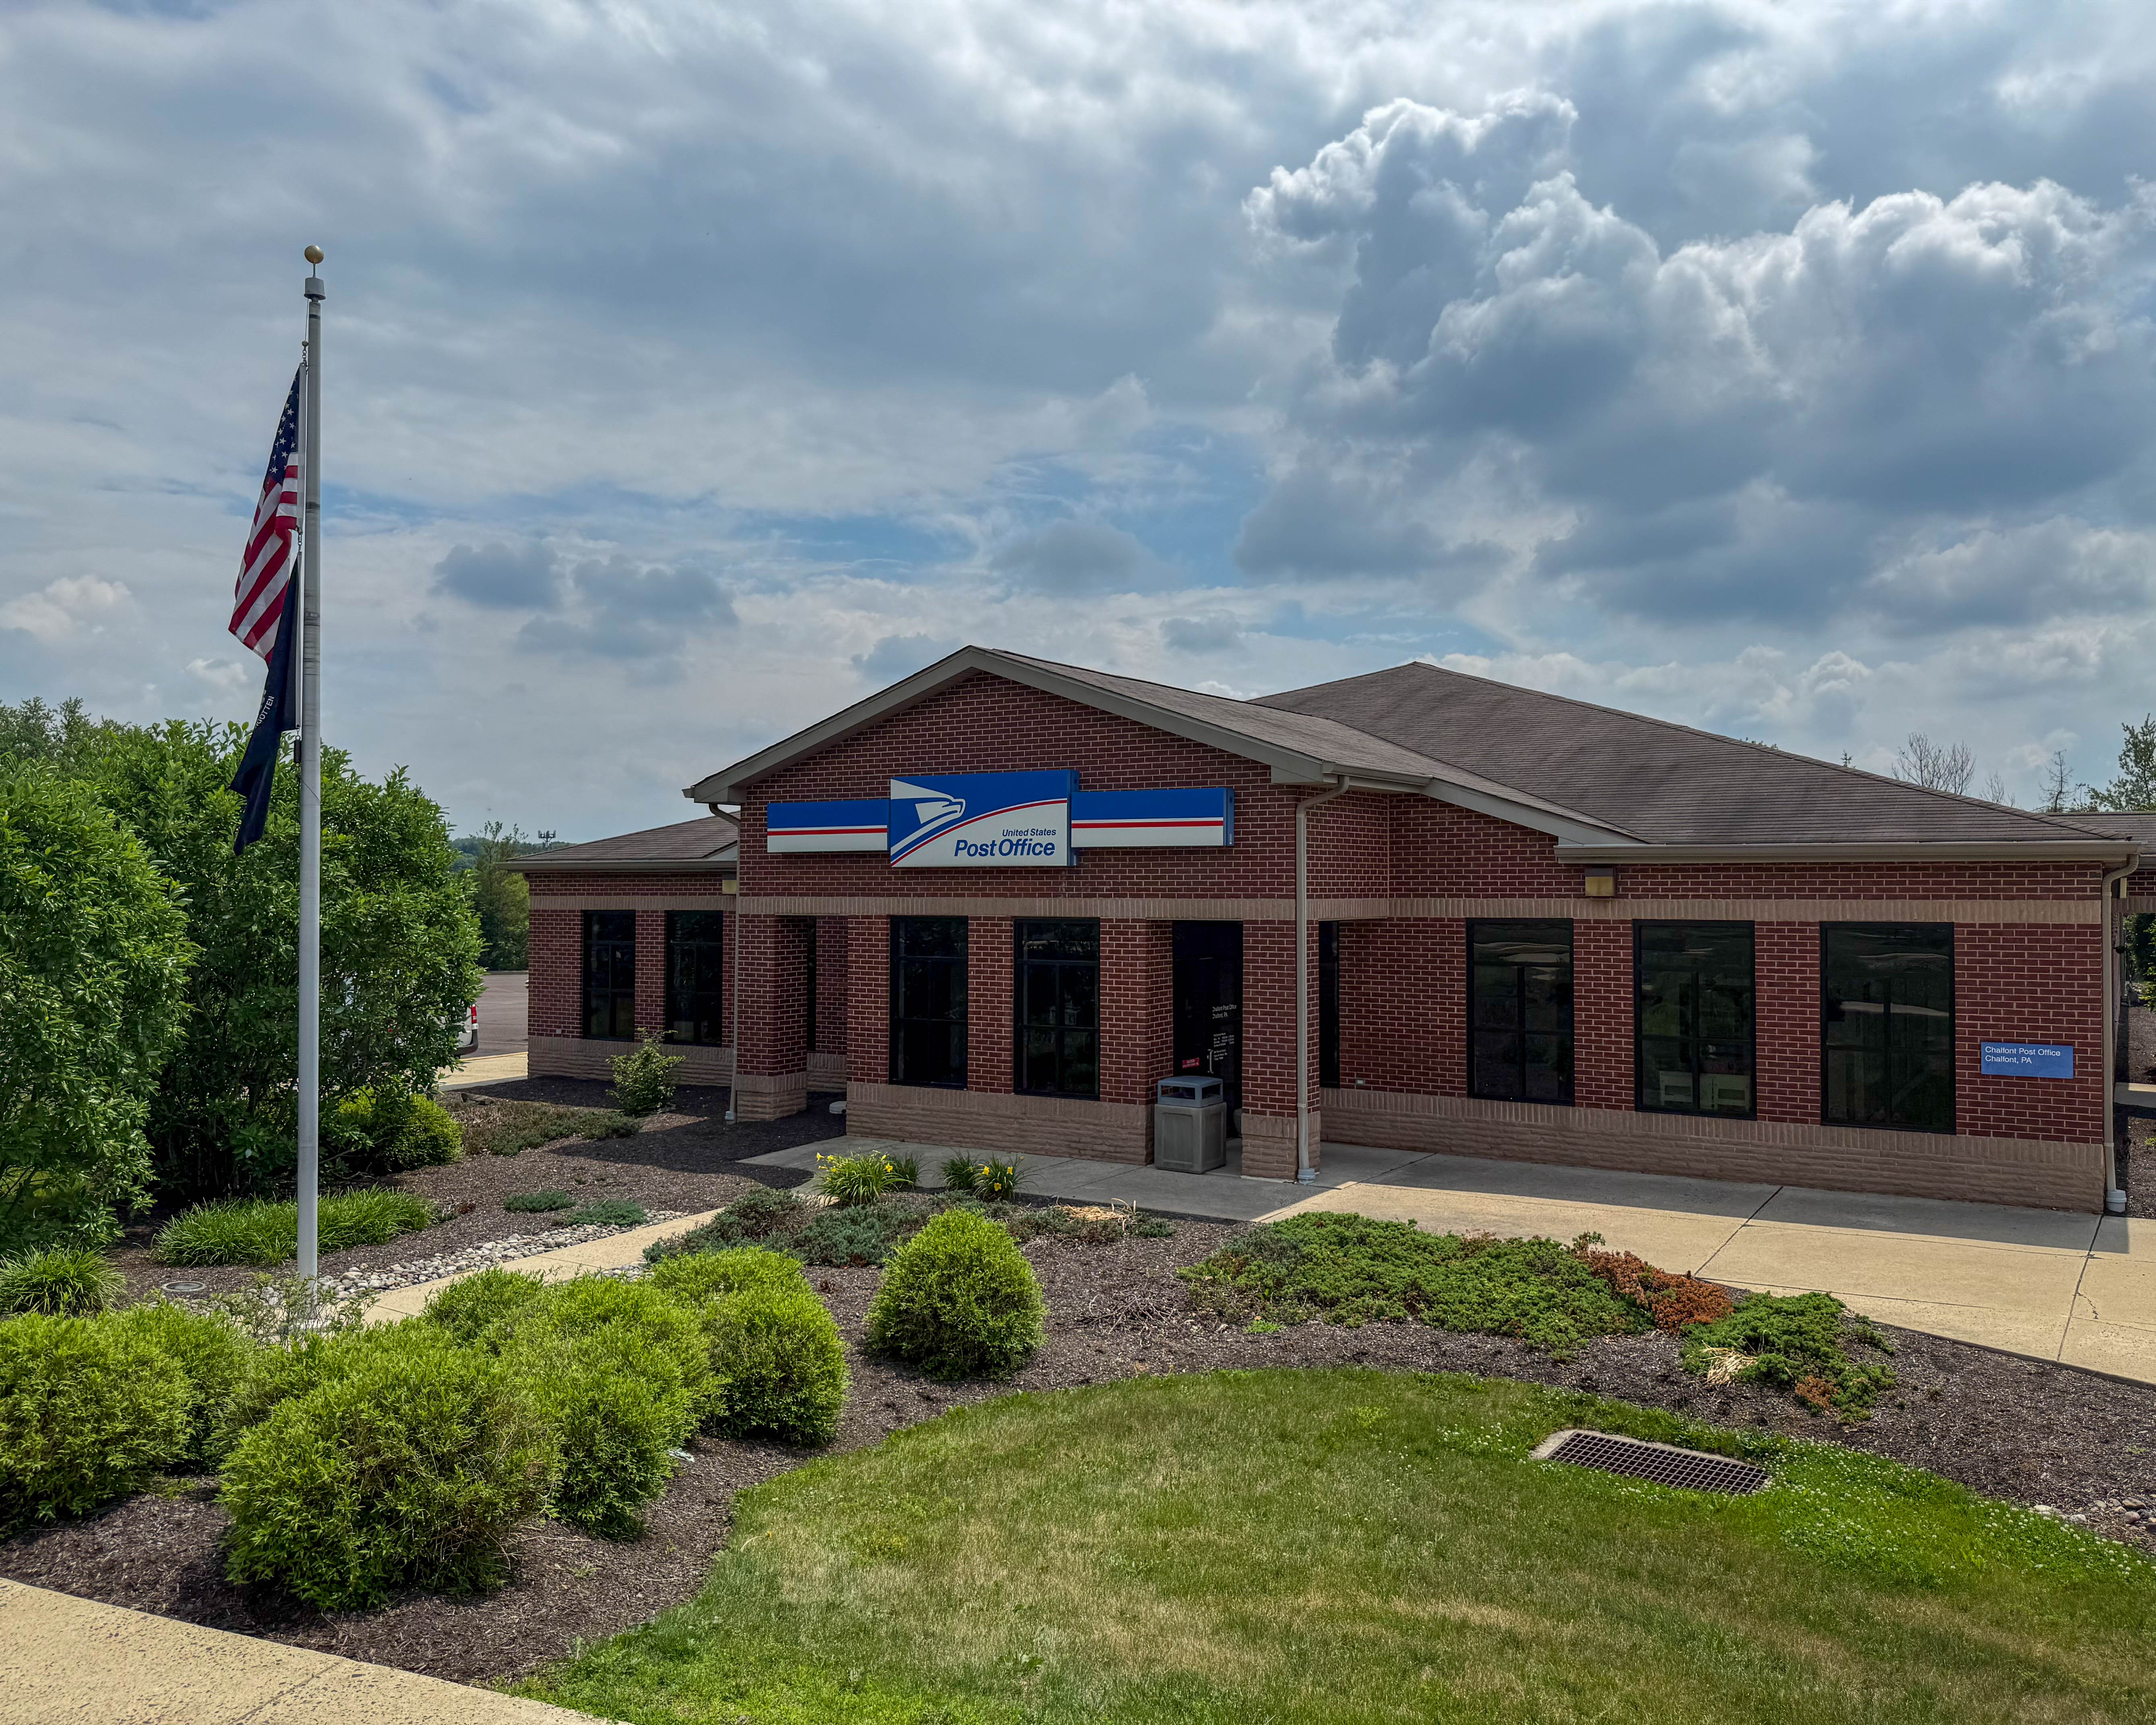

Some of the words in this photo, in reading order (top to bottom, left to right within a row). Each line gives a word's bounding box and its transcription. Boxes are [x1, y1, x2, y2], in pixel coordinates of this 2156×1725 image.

[256, 696, 275, 726] GOTTEN
[1002, 829, 1029, 837] United
[1030, 828, 1056, 836] States
[954, 840, 997, 856] Post
[998, 838, 1055, 856] Office
[1985, 1055, 2019, 1064] Chalfont,
